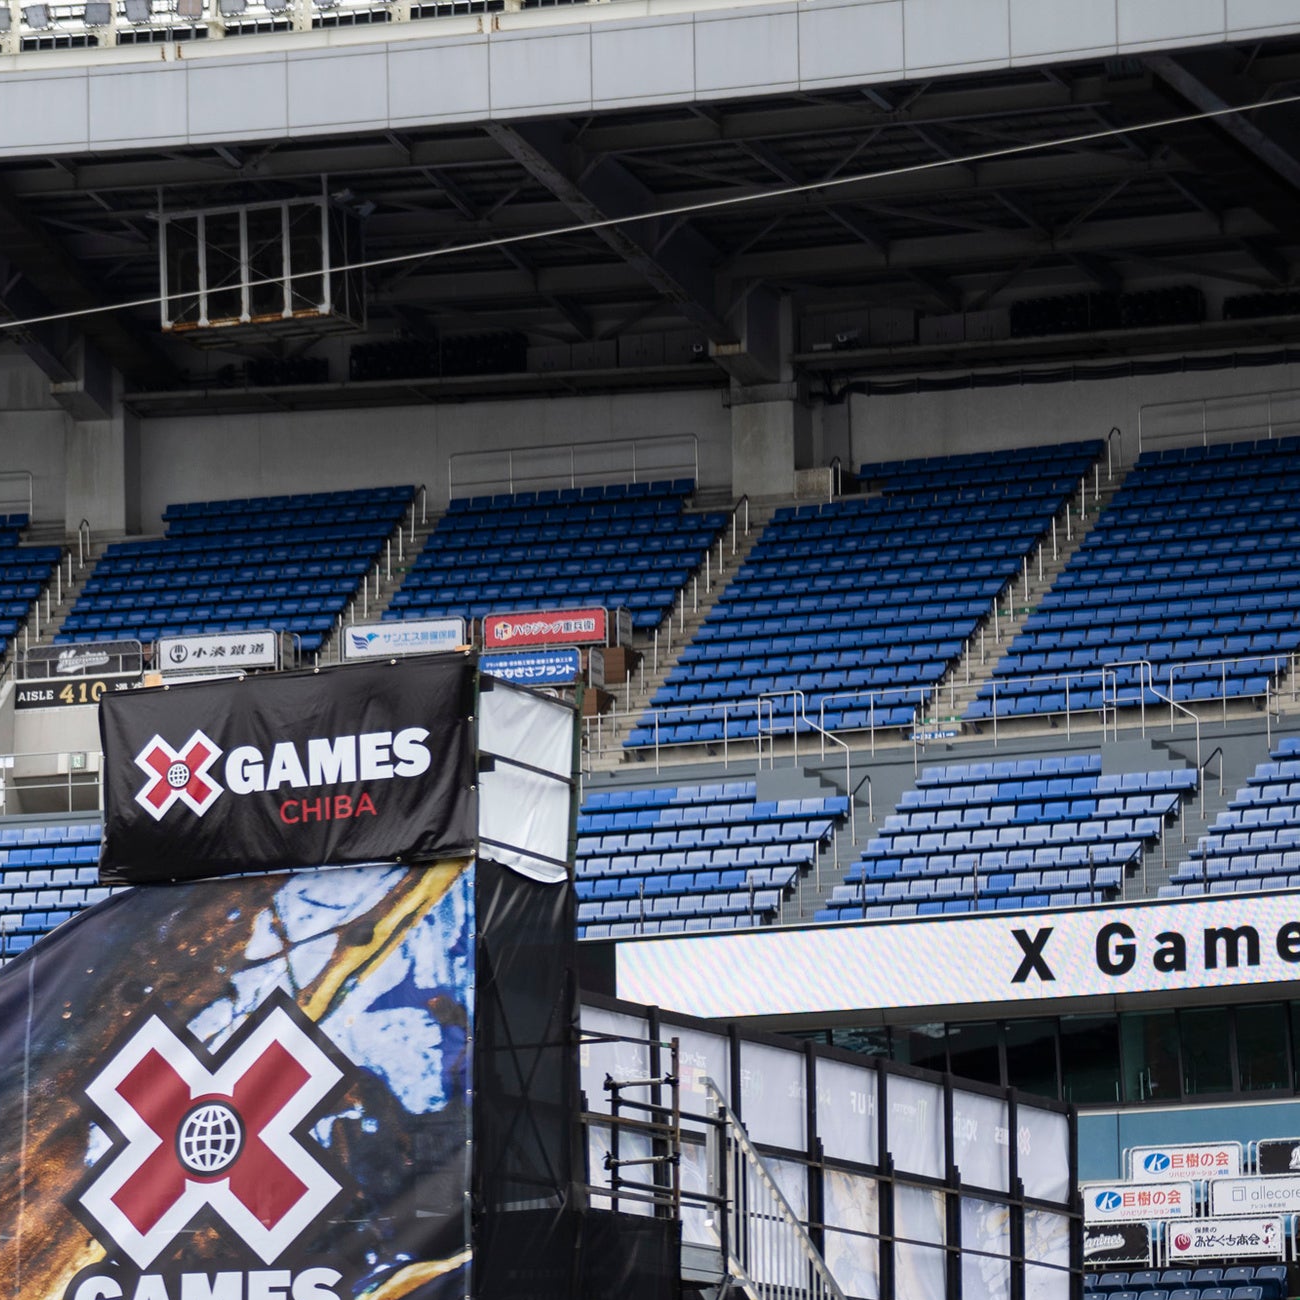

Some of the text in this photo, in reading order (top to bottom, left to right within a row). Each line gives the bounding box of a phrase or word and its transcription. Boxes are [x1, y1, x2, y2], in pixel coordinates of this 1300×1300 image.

[17, 690, 54, 701] AISLE
[59, 681, 107, 703] 410
[225, 726, 432, 795] GAMES
[280, 792, 378, 825] CHIBA
[1010, 921, 1300, 984] X Game
[1171, 1151, 1229, 1169] 巨樹の会
[1122, 1189, 1181, 1207] 巨樹の会
[1195, 1226, 1218, 1234] 保険の
